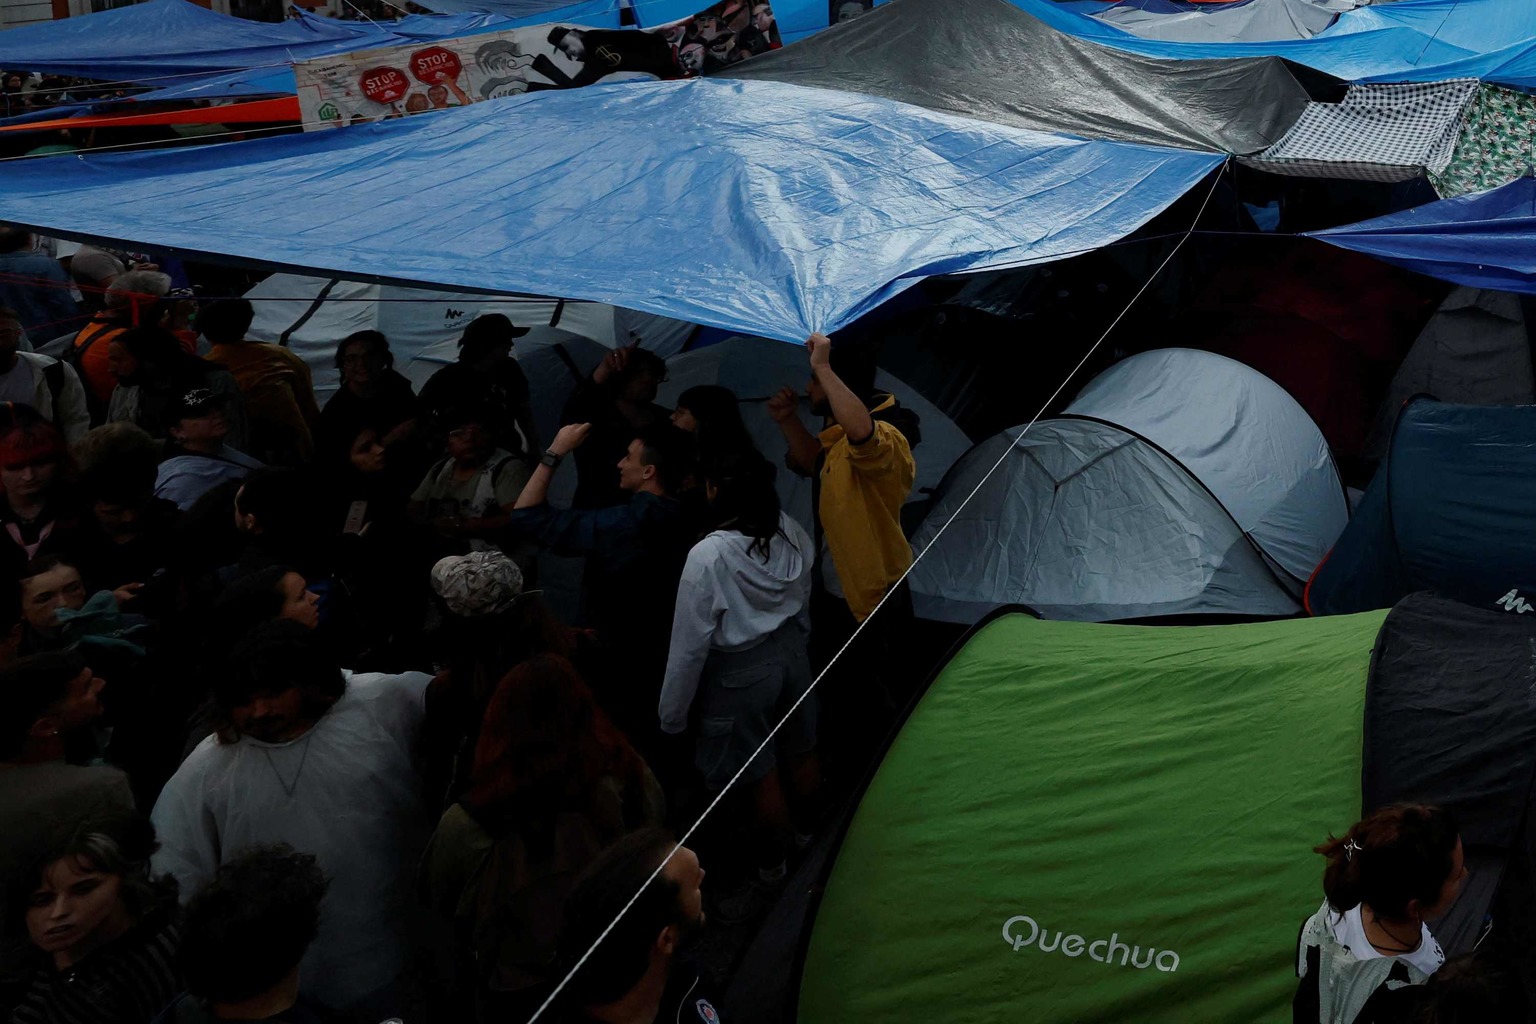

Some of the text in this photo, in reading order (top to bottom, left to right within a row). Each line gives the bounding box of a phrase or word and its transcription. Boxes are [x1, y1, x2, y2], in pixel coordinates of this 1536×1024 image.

[418, 52, 448, 70] STOP
[366, 71, 397, 89] STOP
[1002, 915, 1180, 972] Quechua
